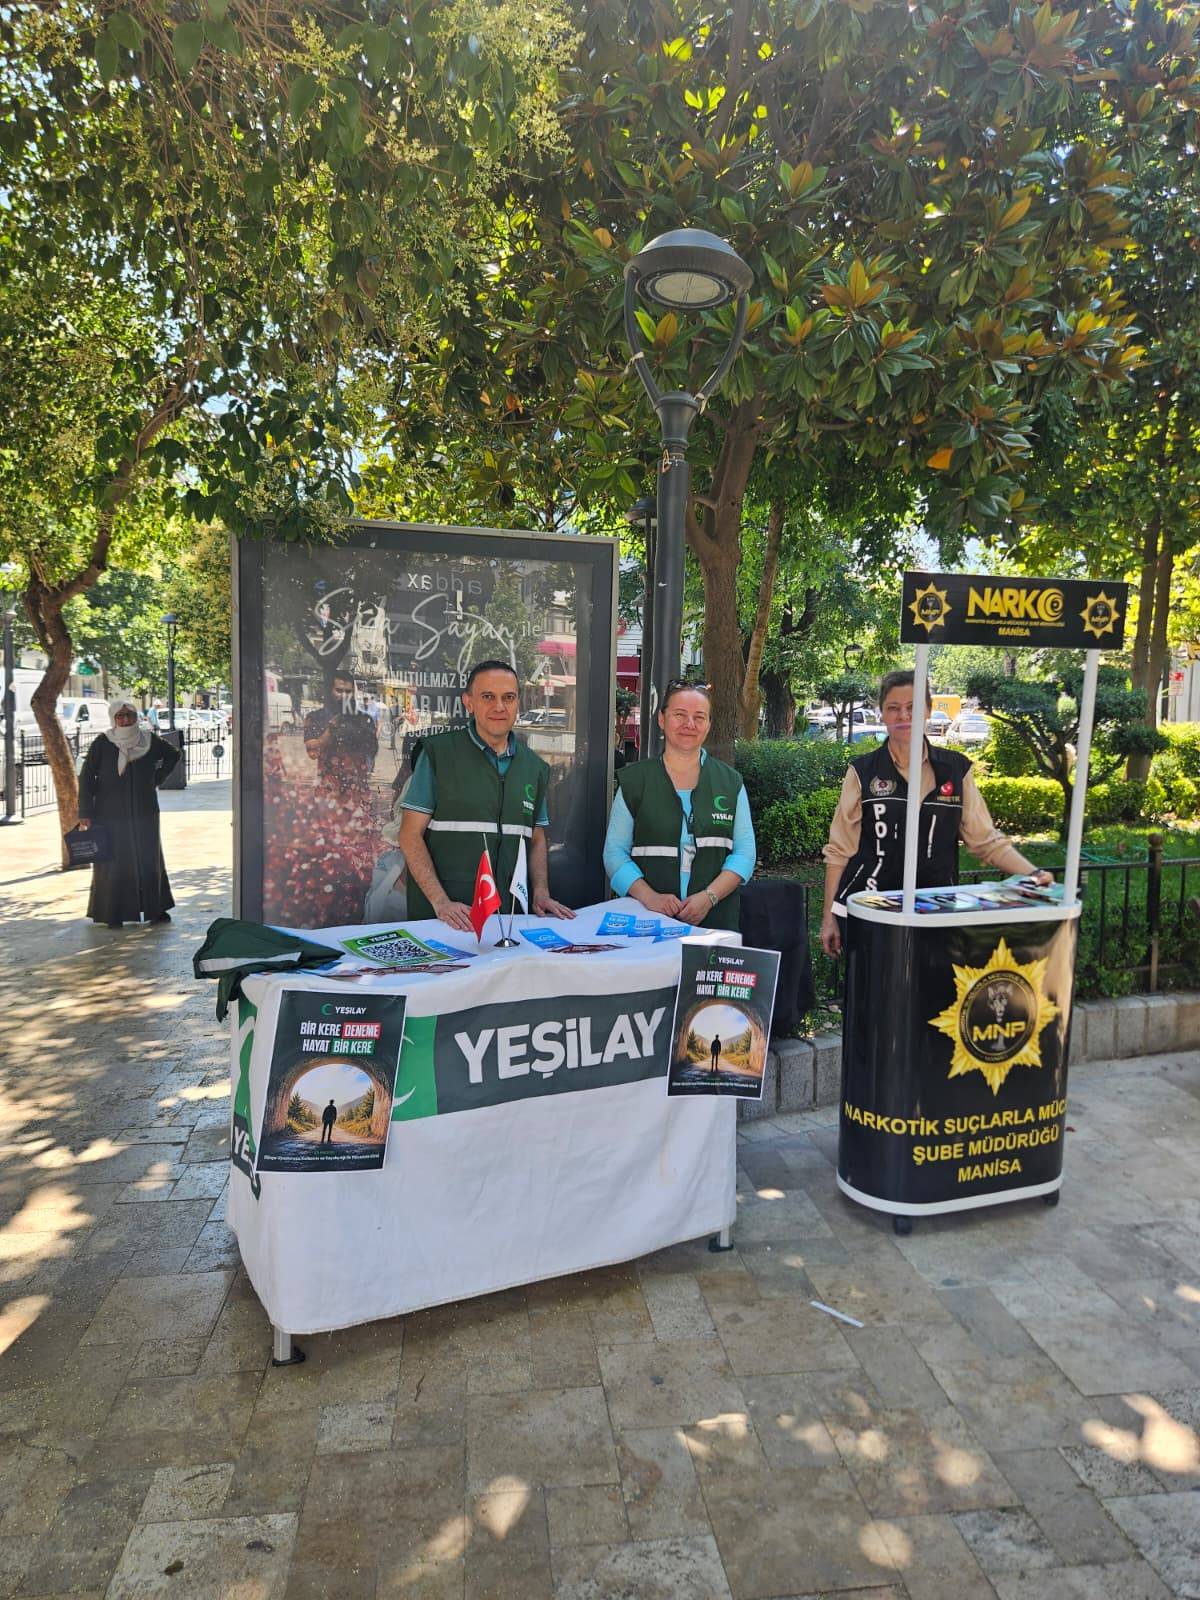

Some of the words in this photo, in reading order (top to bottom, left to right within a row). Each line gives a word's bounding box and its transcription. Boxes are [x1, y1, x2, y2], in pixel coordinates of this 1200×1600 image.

[967, 586, 1065, 622] NARKO
[410, 593, 516, 674] Sayan
[521, 621, 543, 638] ile
[695, 969, 706, 982] BİR
[706, 970, 724, 983] KERE
[725, 972, 756, 986] DENEME
[696, 984, 716, 995] HAYAT
[717, 984, 731, 997] BİR
[731, 986, 751, 999] KERE
[335, 1006, 367, 1015] YEŞİLAY
[300, 1020, 316, 1035] BİR
[317, 1023, 342, 1037] KERE
[343, 1024, 381, 1038] DENEME
[973, 1021, 1026, 1042] MNP
[302, 1038, 331, 1053] HAYAT
[333, 1039, 350, 1054] BİR
[350, 1040, 373, 1055] KERE
[454, 1007, 667, 1084] YEŞİLAY
[844, 1101, 940, 1137] NARKOTİK
[943, 1107, 1035, 1135] SUÇLARLA
[1038, 1098, 1068, 1121] MÜC
[912, 1141, 965, 1166] ŞUBE
[967, 1124, 1060, 1158] MÜDÜRÜĞÜ
[957, 1158, 1022, 1184] MANİSA
